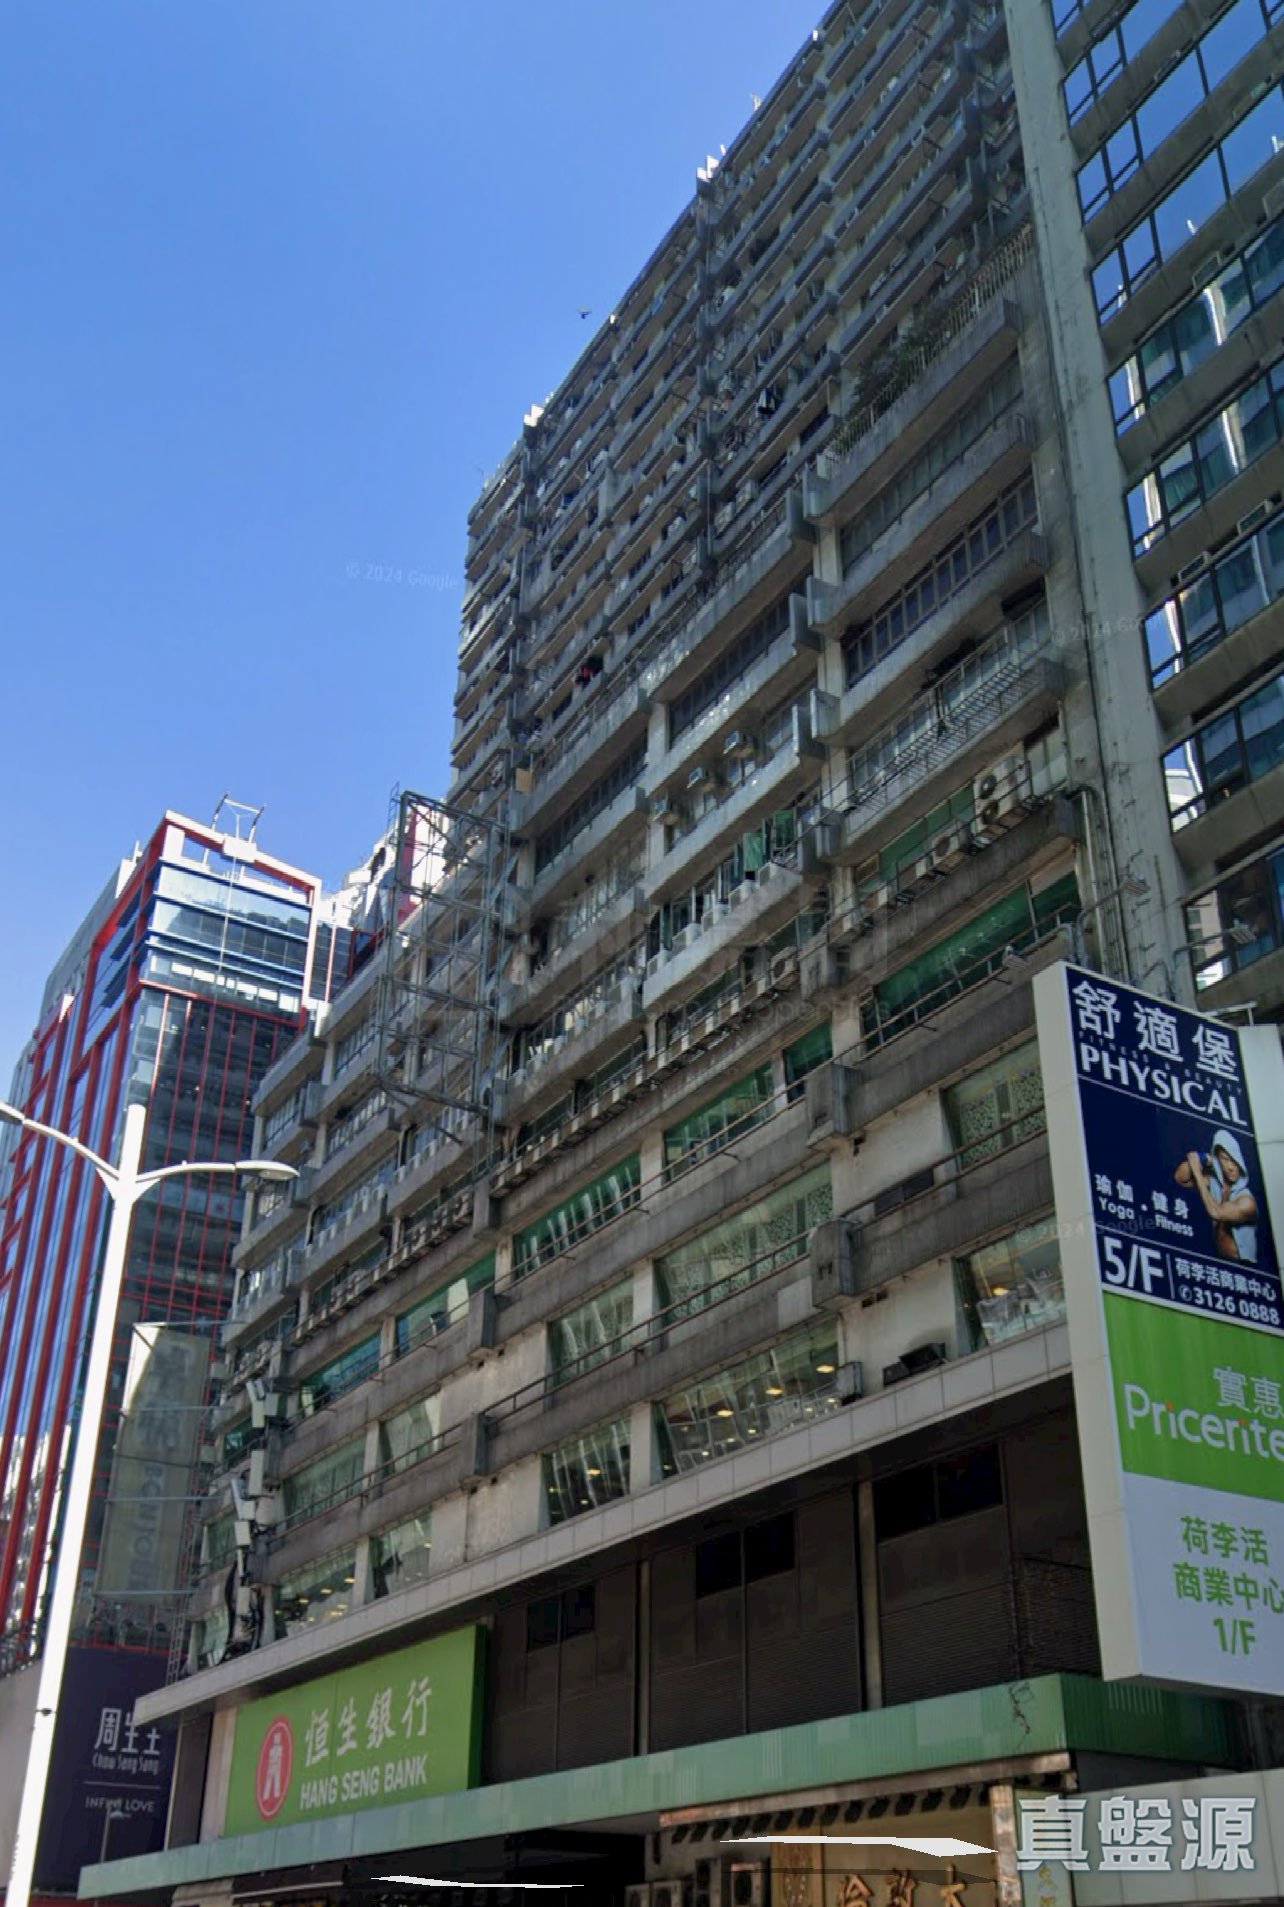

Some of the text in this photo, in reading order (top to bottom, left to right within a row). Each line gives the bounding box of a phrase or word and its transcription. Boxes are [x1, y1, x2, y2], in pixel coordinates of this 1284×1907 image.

[1072, 980, 1239, 1082] 舒適堡
[1080, 1043, 1248, 1126] PHYSICAL
[1099, 1197, 1194, 1237] Yoga Fitness
[1103, 1236, 1164, 1293] 5/F
[1174, 1257, 1277, 1302] 荷李活商業中心
[1193, 1286, 1280, 1325] 3126 0888
[1213, 1366, 1284, 1419] 實惠
[1123, 1383, 1284, 1462] Pricerite
[1180, 1515, 1269, 1567] 荷李活
[1172, 1562, 1284, 1614] 商業中心
[1213, 1617, 1256, 1655] 1/F
[304, 1677, 432, 1767] 恒生銀行
[125, 1798, 155, 1813] LOVE
[300, 1755, 428, 1809] HANG SENG BANK
